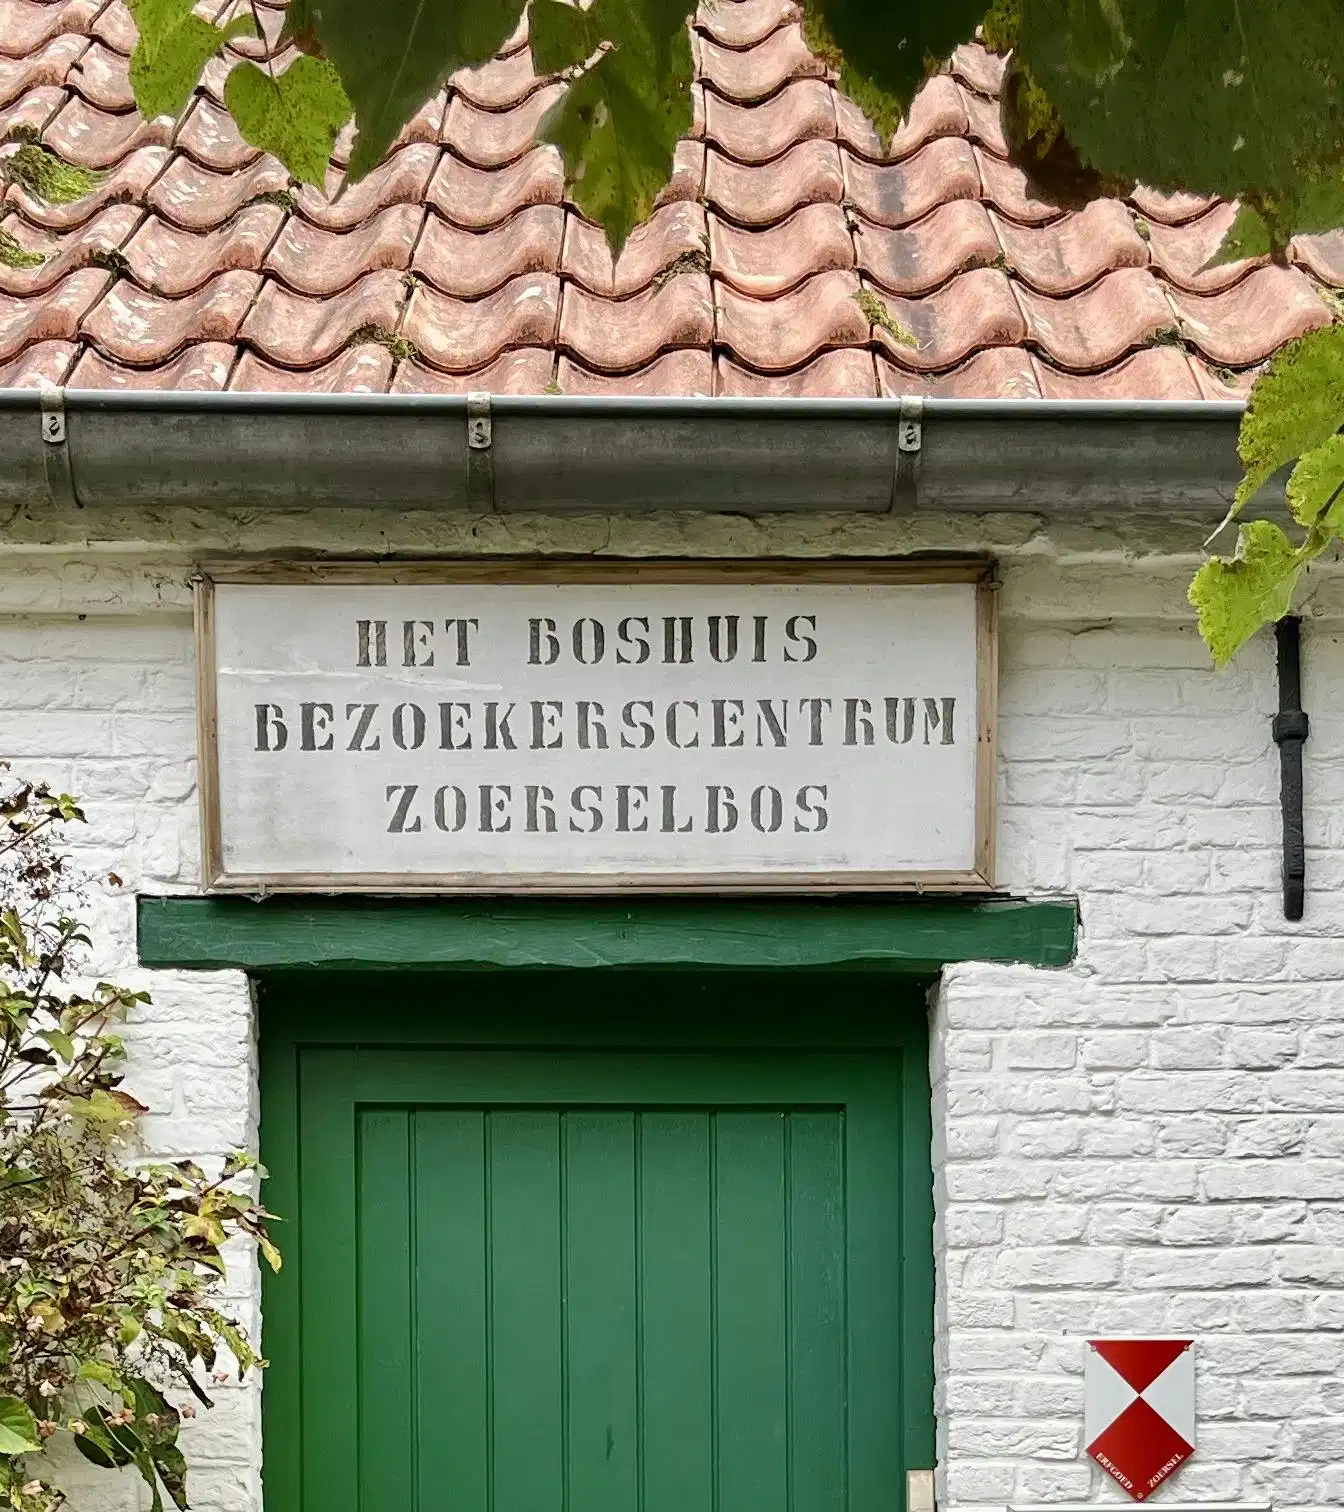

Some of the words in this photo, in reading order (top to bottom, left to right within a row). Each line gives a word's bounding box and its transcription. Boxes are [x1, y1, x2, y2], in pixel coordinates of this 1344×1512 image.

[354, 616, 480, 668] HET
[527, 613, 819, 666] BOSHUIS
[253, 695, 959, 752] BEZOEKERSCENTRUM
[384, 782, 831, 834] ZOERSELBOS
[1095, 1452, 1133, 1489] ERFGOED
[1147, 1453, 1184, 1488] ZOERSEL
